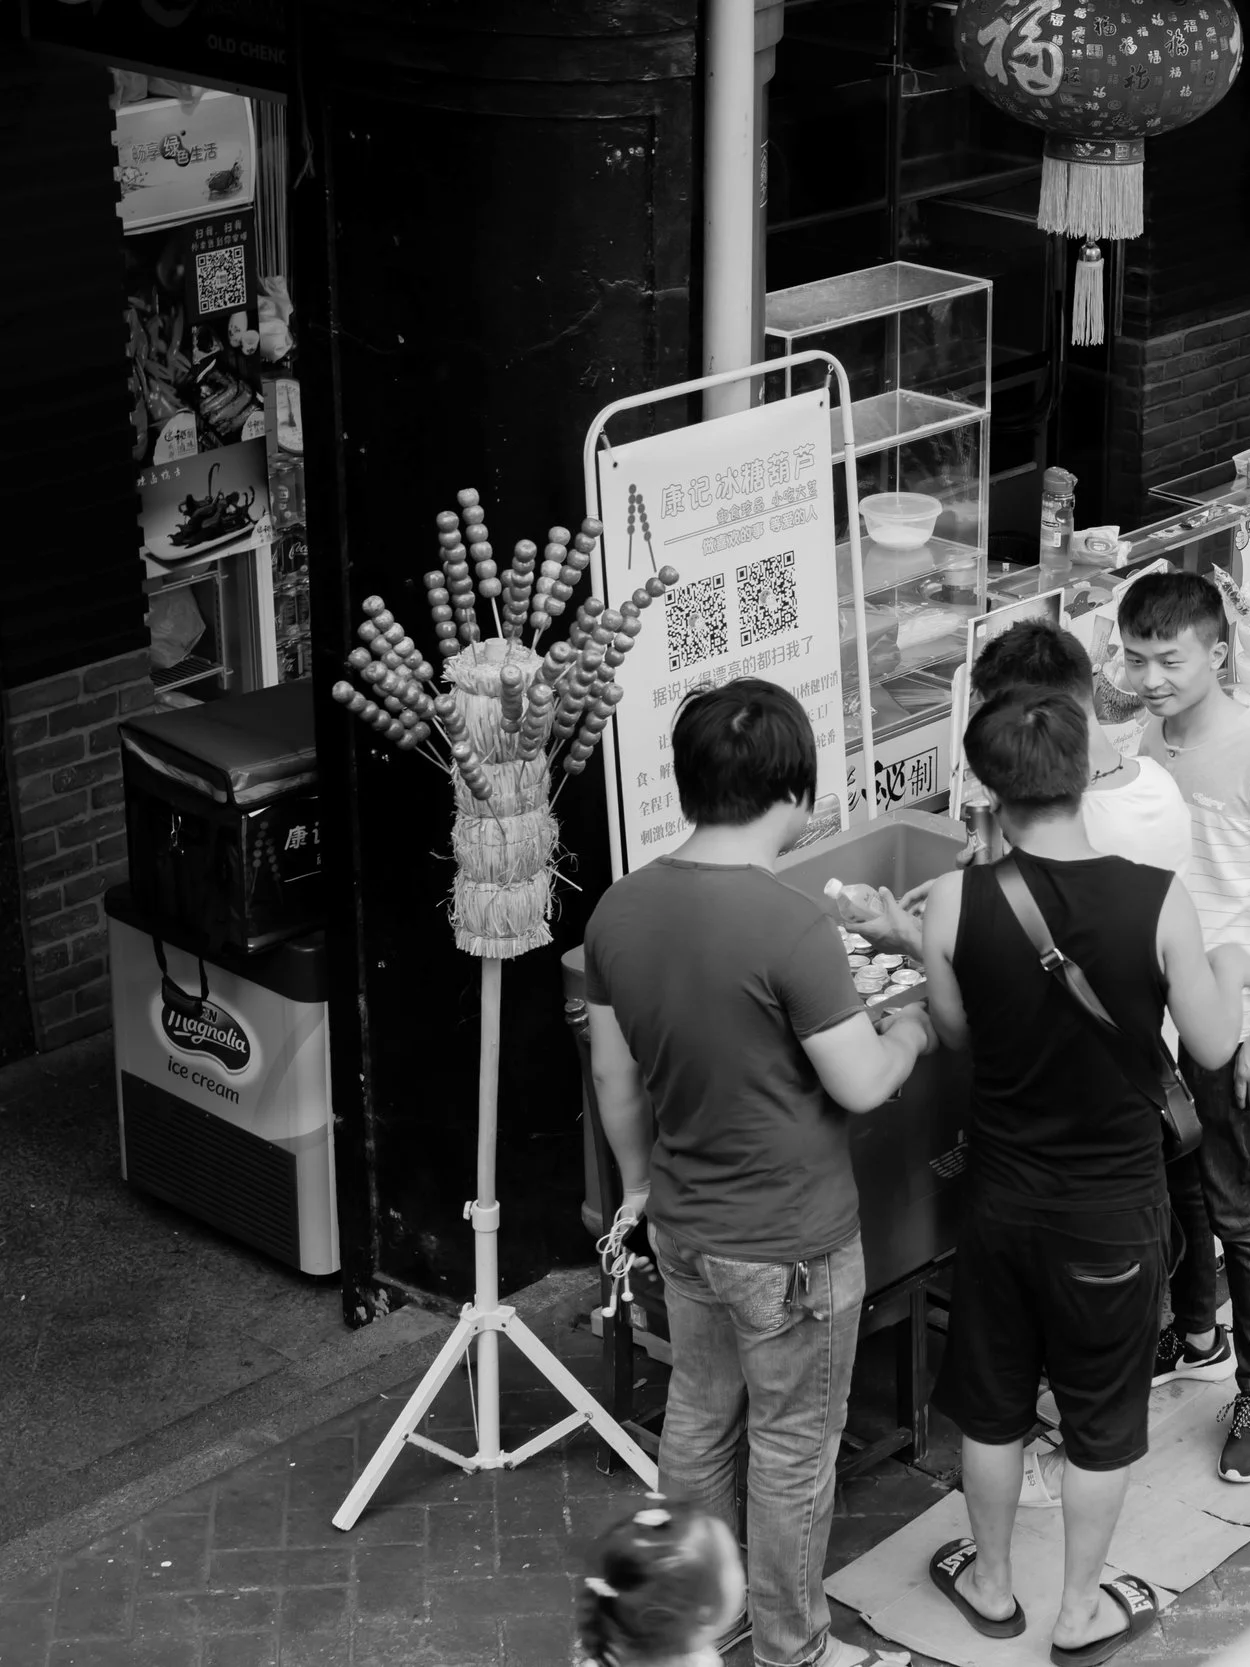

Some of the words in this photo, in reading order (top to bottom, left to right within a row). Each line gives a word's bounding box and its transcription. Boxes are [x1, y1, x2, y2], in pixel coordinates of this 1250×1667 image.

[207, 34, 237, 54] OLD
[660, 443, 816, 519] 康记冰糖葫芦
[701, 522, 764, 556] 做喜欢的事
[652, 635, 814, 708] 据说长得漂亮的都扫我了
[168, 1009, 248, 1054] Magnolia
[168, 1055, 188, 1079] ice
[191, 1072, 240, 1105] cream
